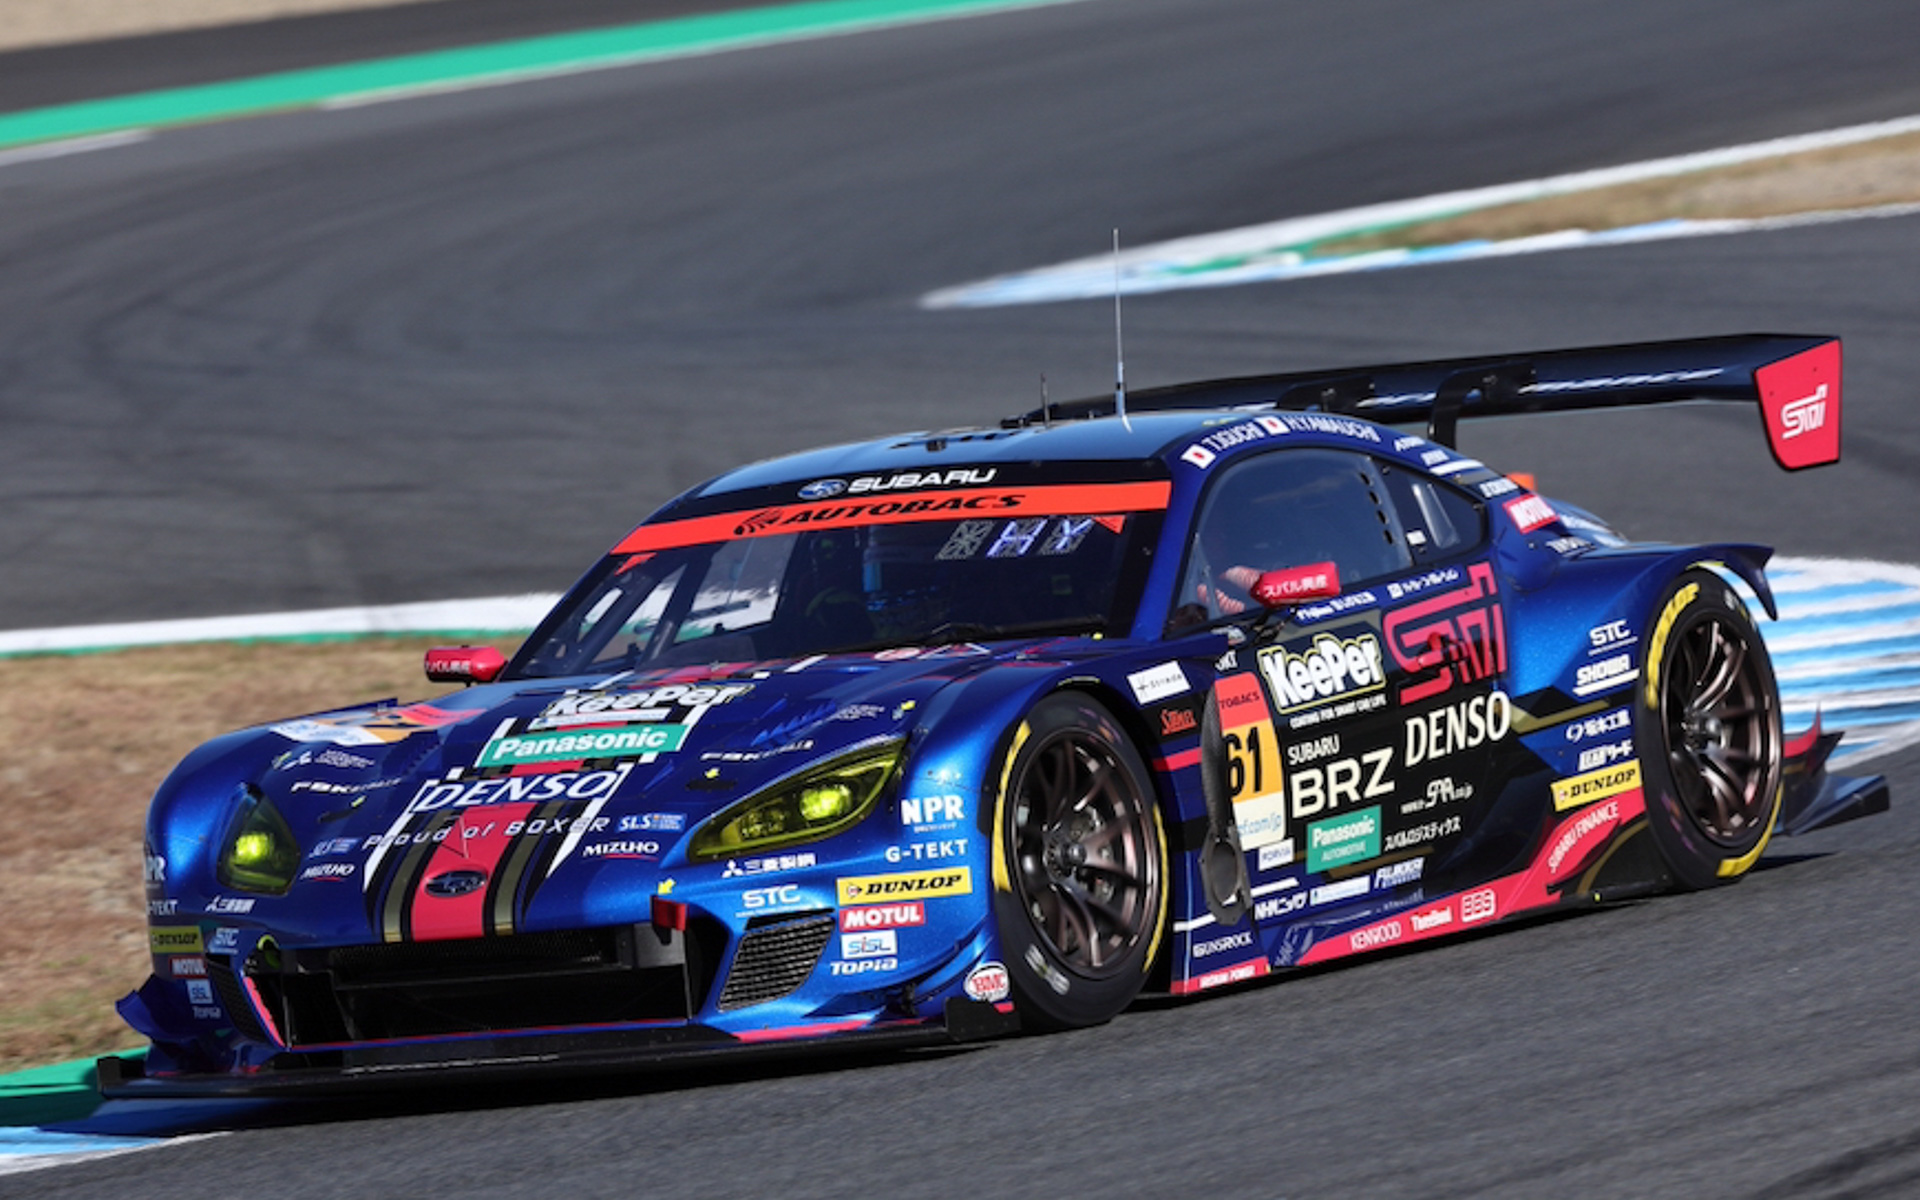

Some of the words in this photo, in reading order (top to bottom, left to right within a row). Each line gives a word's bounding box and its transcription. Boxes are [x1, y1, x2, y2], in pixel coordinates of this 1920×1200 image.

[848, 468, 996, 493] SUBARU
[783, 495, 1025, 525] AUTOBACS
[1589, 619, 1630, 646] STC
[1262, 638, 1383, 708] KeePer
[545, 684, 750, 717] KeePer
[493, 727, 667, 760] Panasonic
[1405, 691, 1511, 768] DENSO
[1222, 726, 1263, 797] 61
[1287, 733, 1340, 766] SUBARU
[411, 771, 617, 811] DENSO
[1290, 748, 1395, 818] BRZ
[1570, 768, 1636, 798] DUNLOP
[901, 795, 964, 826] NPR
[463, 822, 495, 841] of
[505, 817, 609, 837] BOXER
[1311, 815, 1375, 849] Panasonic
[583, 841, 659, 857] MIZUHO
[885, 839, 969, 863] G-TEKT
[743, 884, 801, 908] STC
[866, 875, 962, 896] DUNLOP
[844, 906, 921, 929] MOTUL
[1350, 921, 1402, 950] KENWOOD
